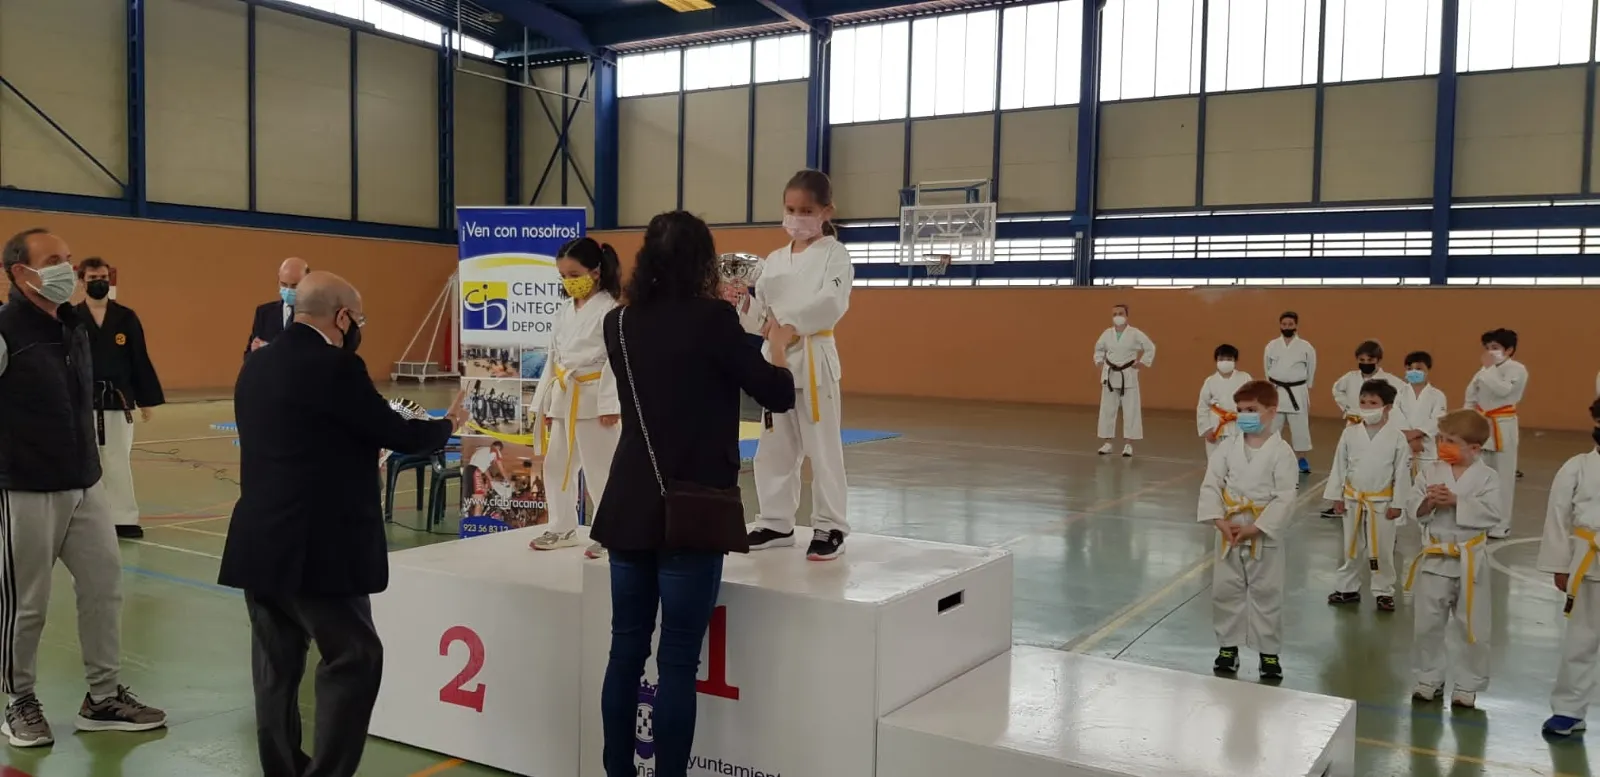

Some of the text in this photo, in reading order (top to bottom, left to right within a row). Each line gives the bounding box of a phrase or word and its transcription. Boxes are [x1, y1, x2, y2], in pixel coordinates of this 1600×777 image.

[462, 221, 580, 242] ¡Ven con nosotros!
[463, 524, 477, 532] 923
[478, 525, 487, 533] 56
[488, 525, 498, 533] 83
[439, 625, 486, 713] 2
[696, 605, 740, 700] 1
